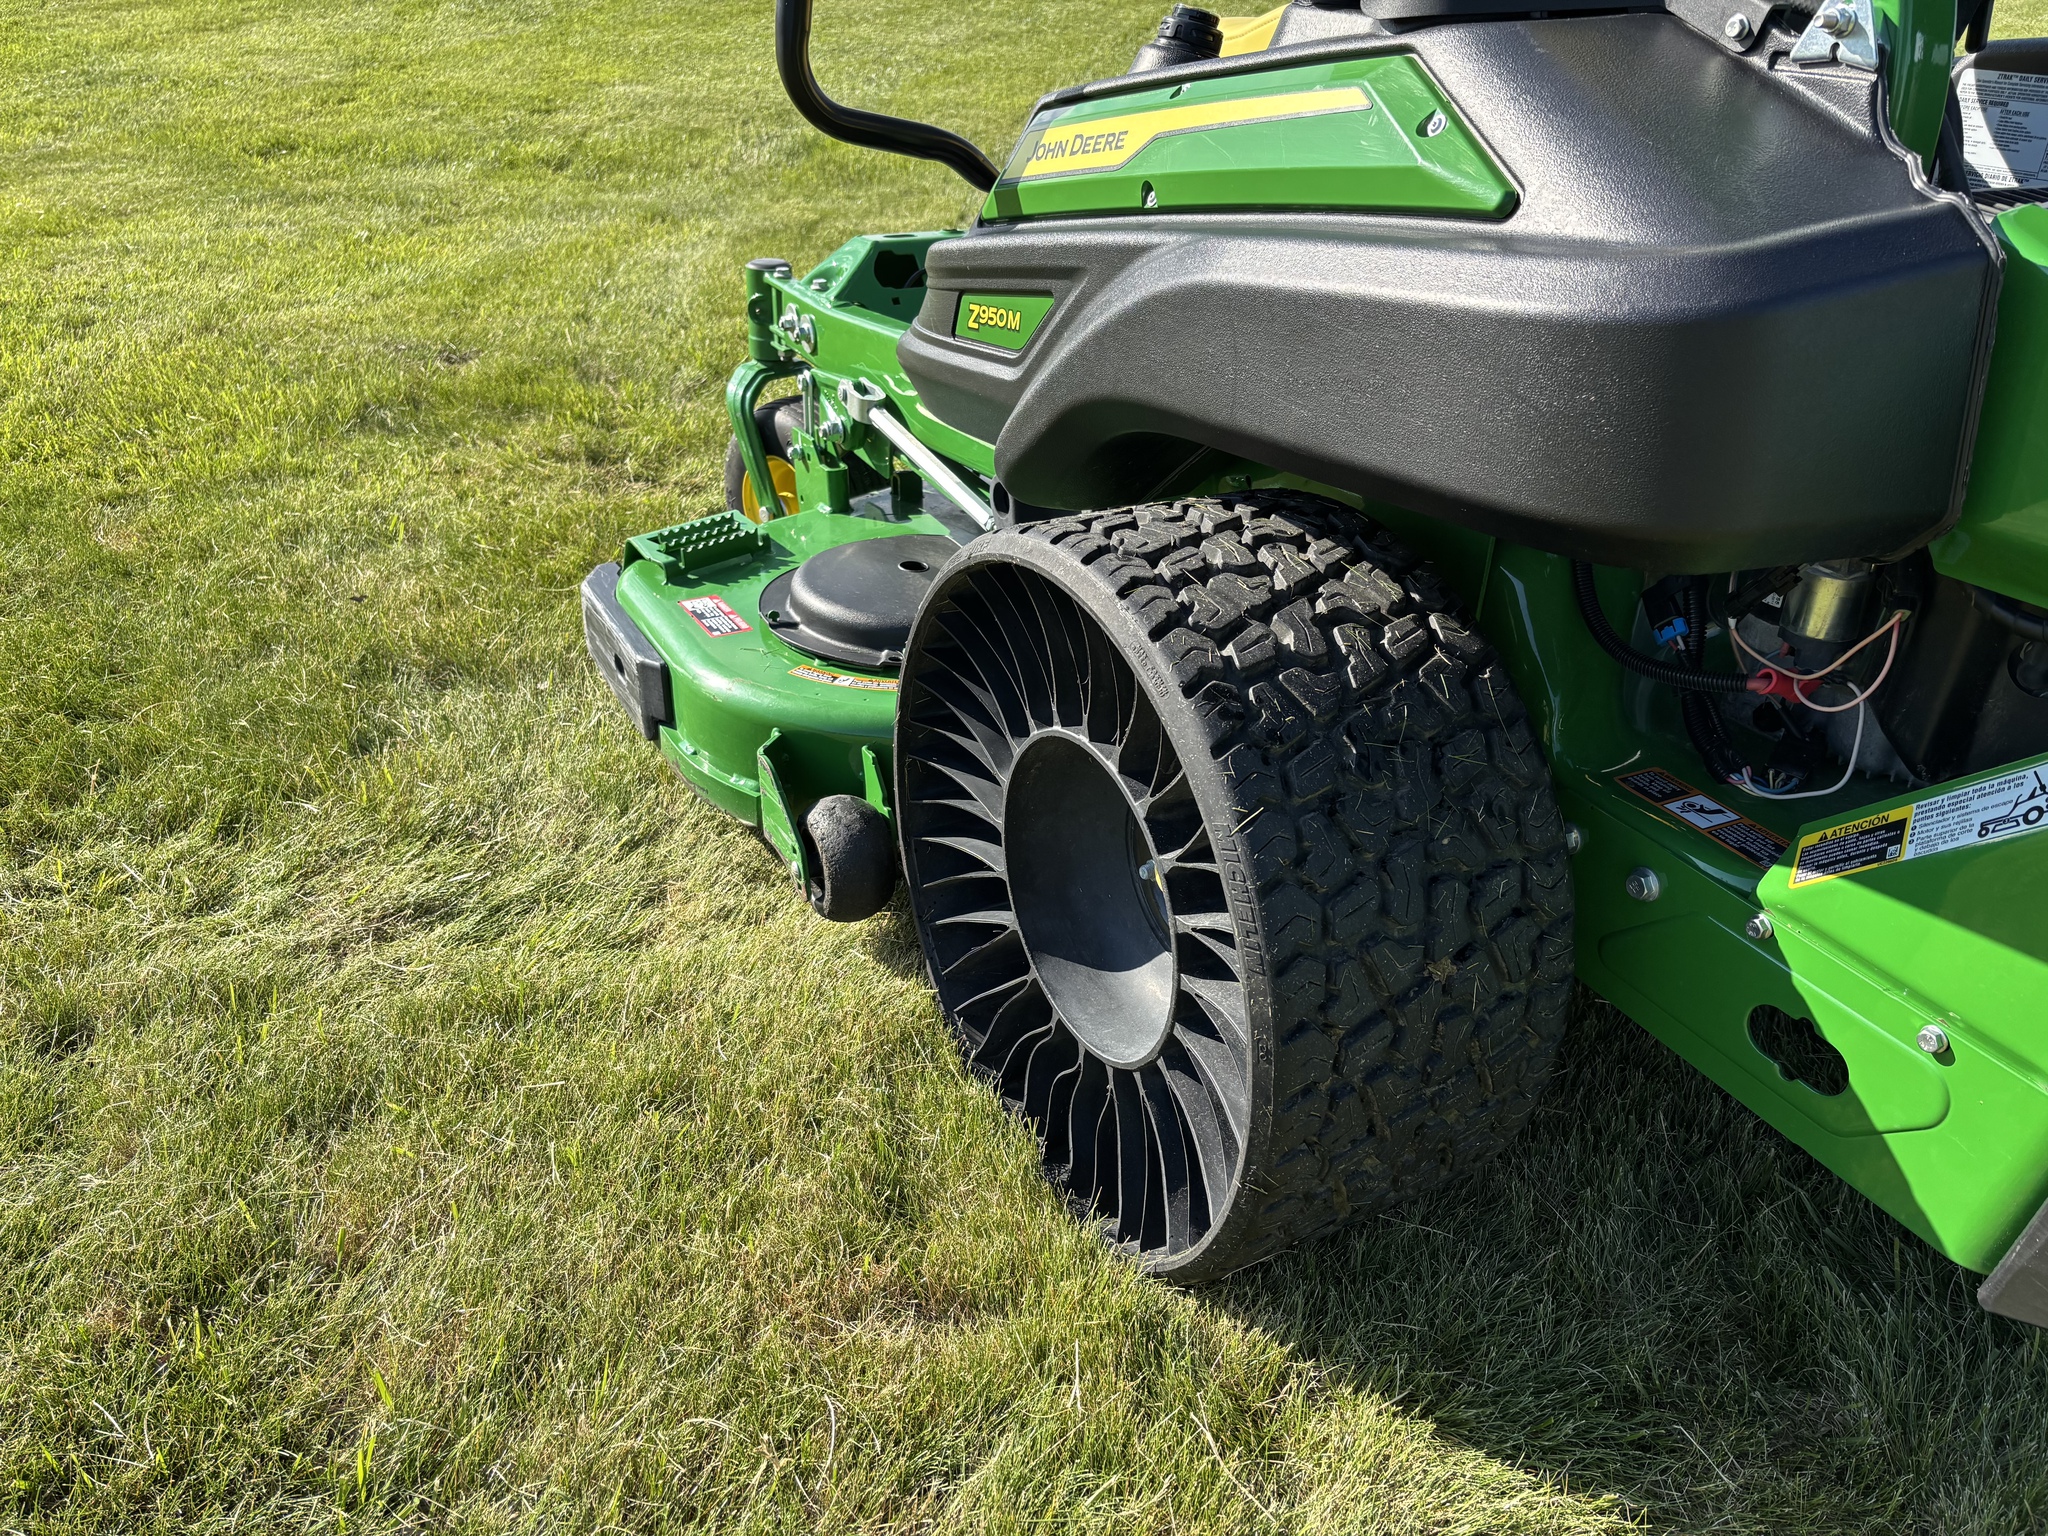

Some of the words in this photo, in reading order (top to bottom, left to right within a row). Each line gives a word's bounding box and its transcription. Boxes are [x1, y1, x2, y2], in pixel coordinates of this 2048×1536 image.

[1026, 140, 1069, 163] JOHN
[1069, 130, 1128, 156] DEERE
[1965, 171, 1983, 179] ERVICIO
[1984, 172, 2000, 180] DIARIO
[1914, 804, 1946, 818] prestando
[1947, 795, 1975, 809] especial
[1977, 786, 2005, 799] atención
[1916, 799, 1940, 810] Revisar
[1946, 790, 1970, 801] limpiar
[1972, 786, 1986, 794] toda
[1997, 774, 2028, 787] máquina,
[1830, 813, 1889, 838] ATENCIÓN
[1913, 814, 1934, 825] puntos
[1935, 803, 1971, 817] siguientes:
[1919, 817, 1951, 829] Silenciador
[1957, 809, 1980, 818] sistema
[1917, 827, 1934, 836] Motor
[1933, 827, 1958, 838] superior
[1212, 822, 1266, 976] MICHELIN
